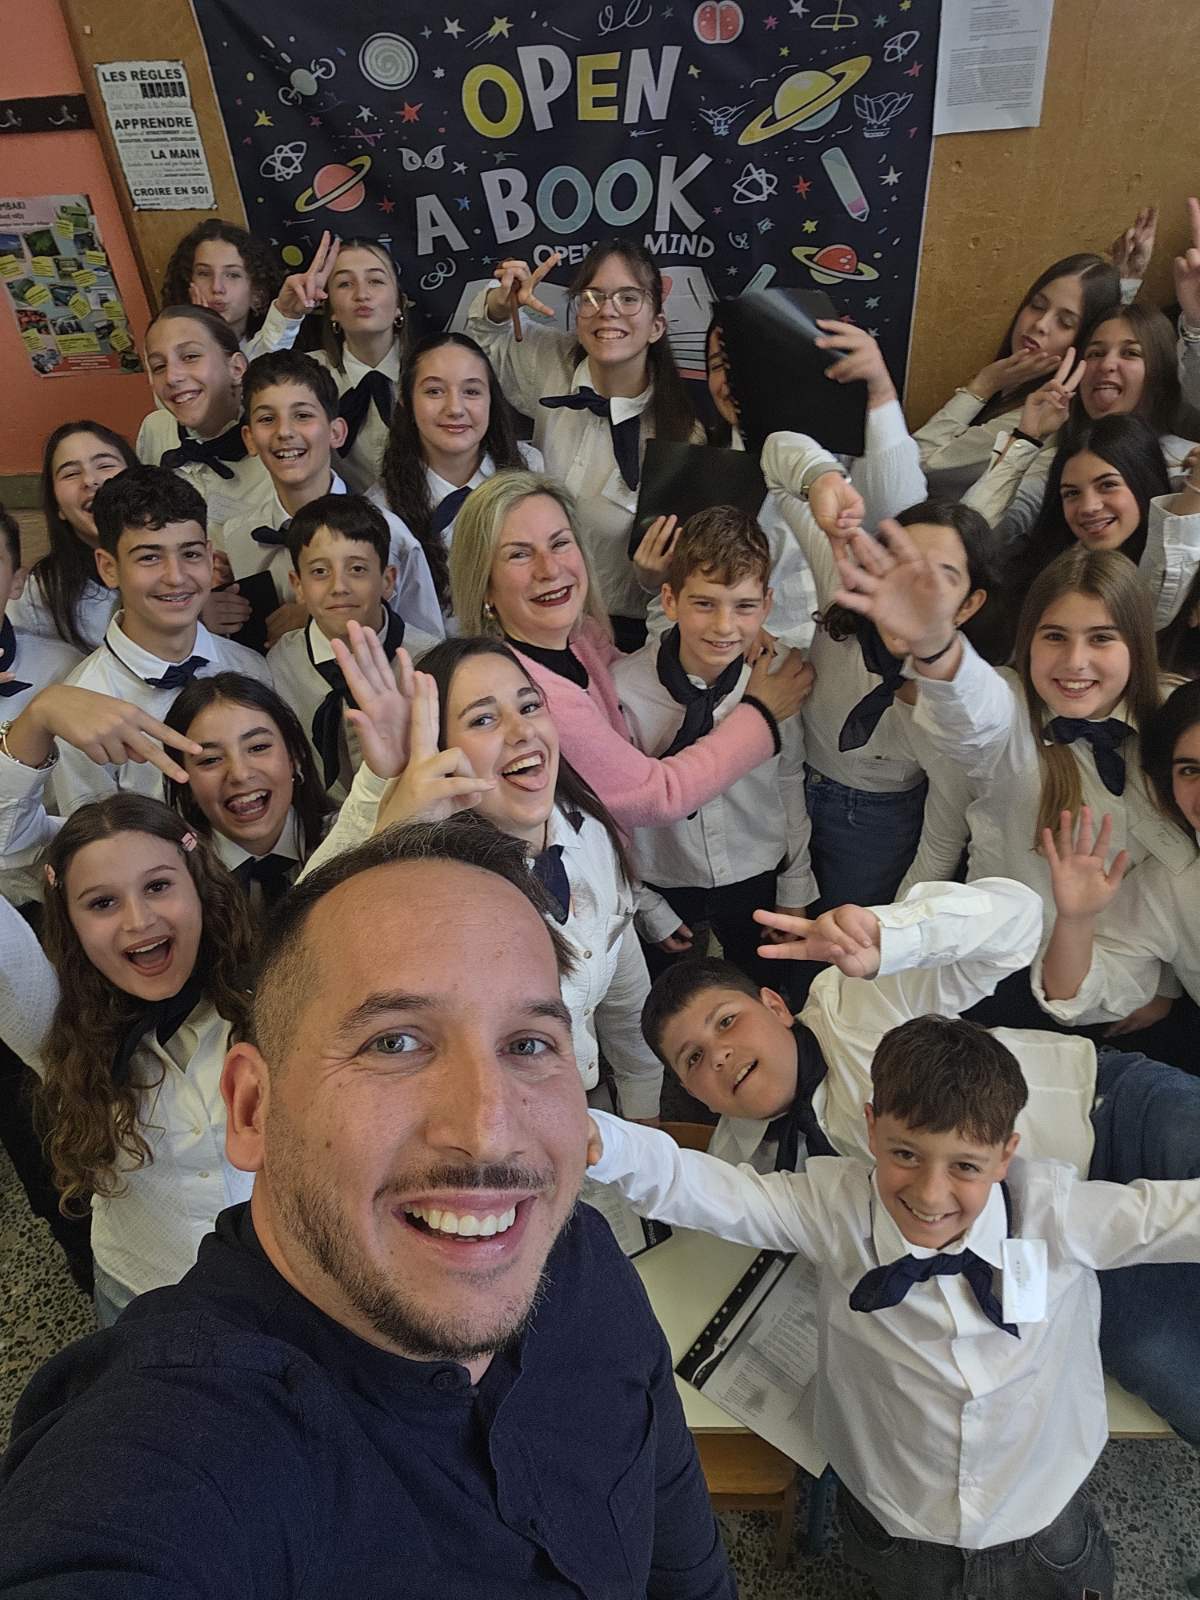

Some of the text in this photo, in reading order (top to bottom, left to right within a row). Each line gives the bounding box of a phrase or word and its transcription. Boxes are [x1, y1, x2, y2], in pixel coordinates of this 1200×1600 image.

[102, 67, 182, 82] LES RÈGLES
[462, 44, 682, 138] OPEN
[115, 116, 194, 130] APPRENDRE
[150, 149, 167, 160] LA
[169, 148, 200, 159] MAIN
[133, 186, 209, 197] CROIRE EN SOI
[415, 153, 713, 256] A BOOK
[644, 233, 715, 258] MIND
